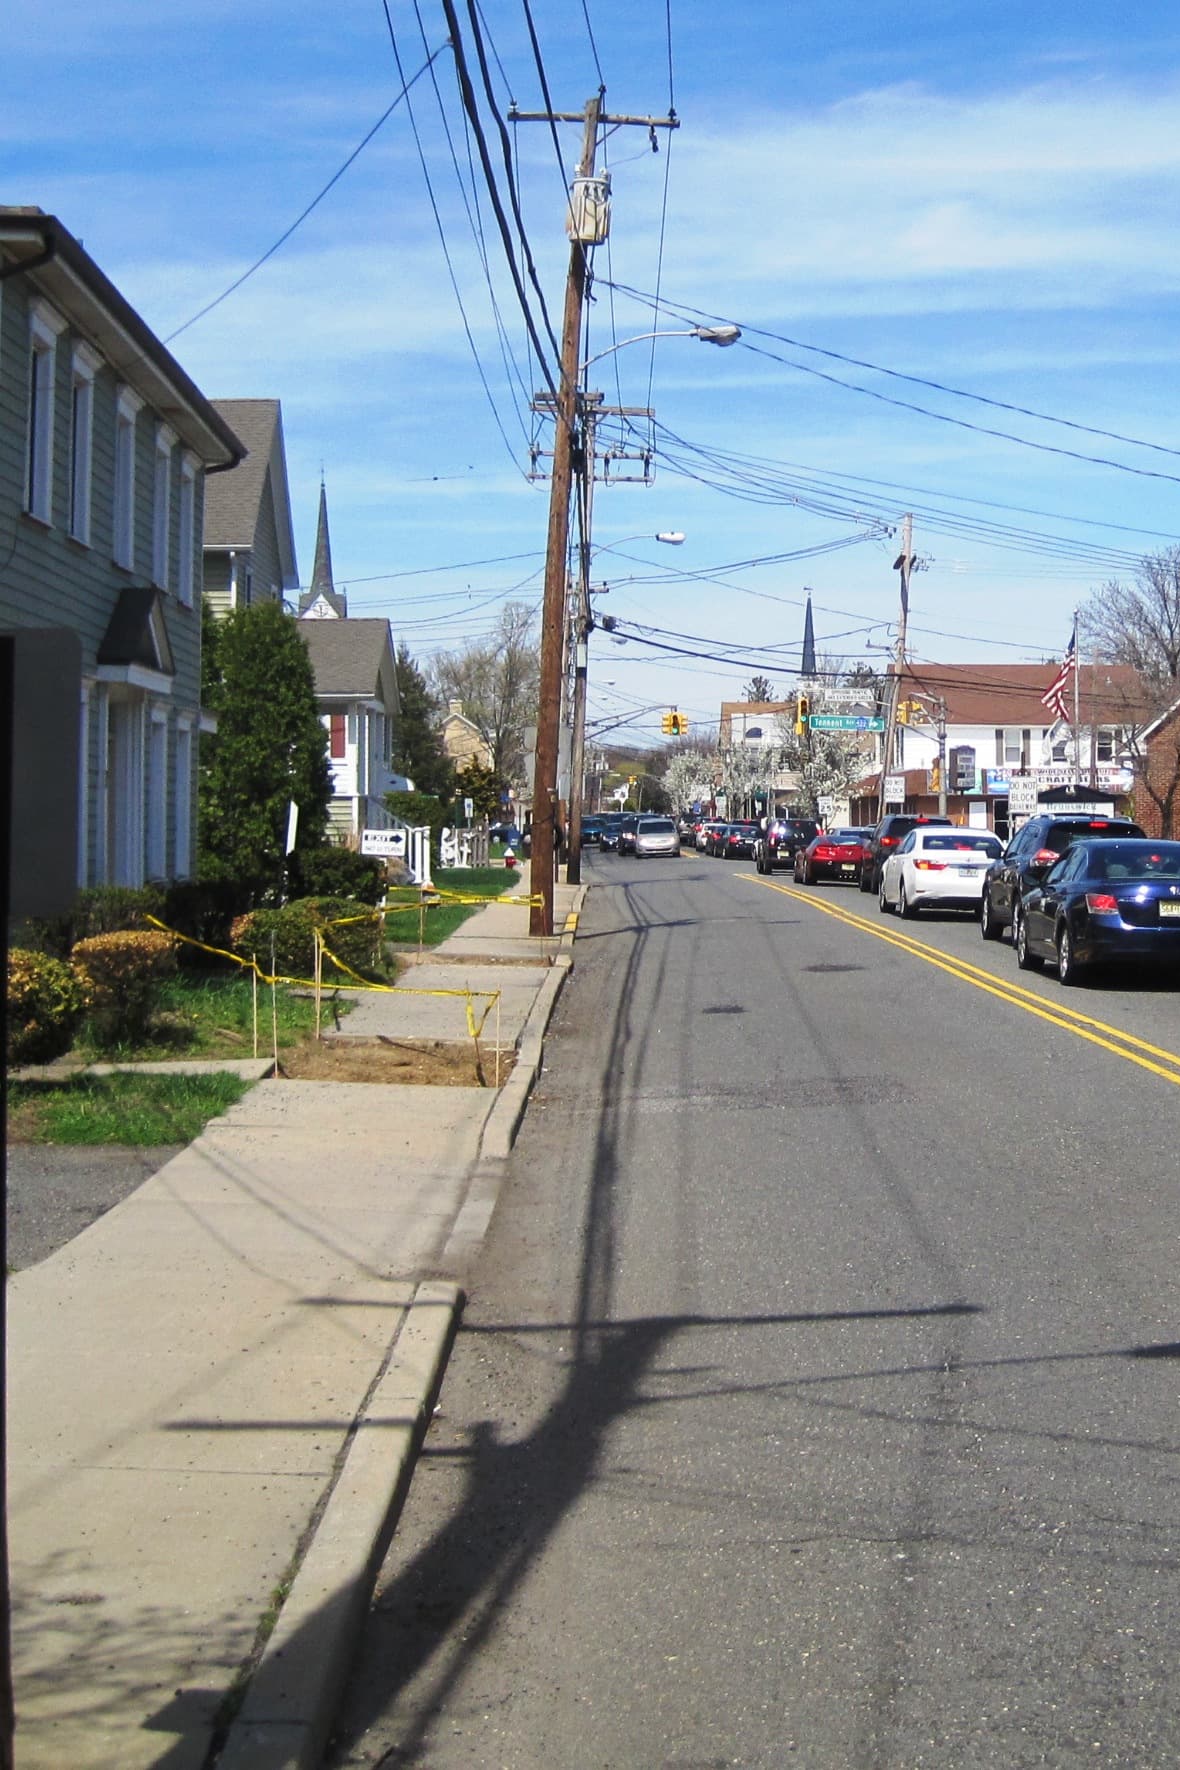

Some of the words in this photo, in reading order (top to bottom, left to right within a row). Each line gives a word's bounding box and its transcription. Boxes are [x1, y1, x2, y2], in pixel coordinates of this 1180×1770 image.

[1010, 781, 1019, 790] DO
[1022, 781, 1036, 790] NOT
[1011, 793, 1034, 801] BLOCK
[366, 834, 390, 842] EXIT
